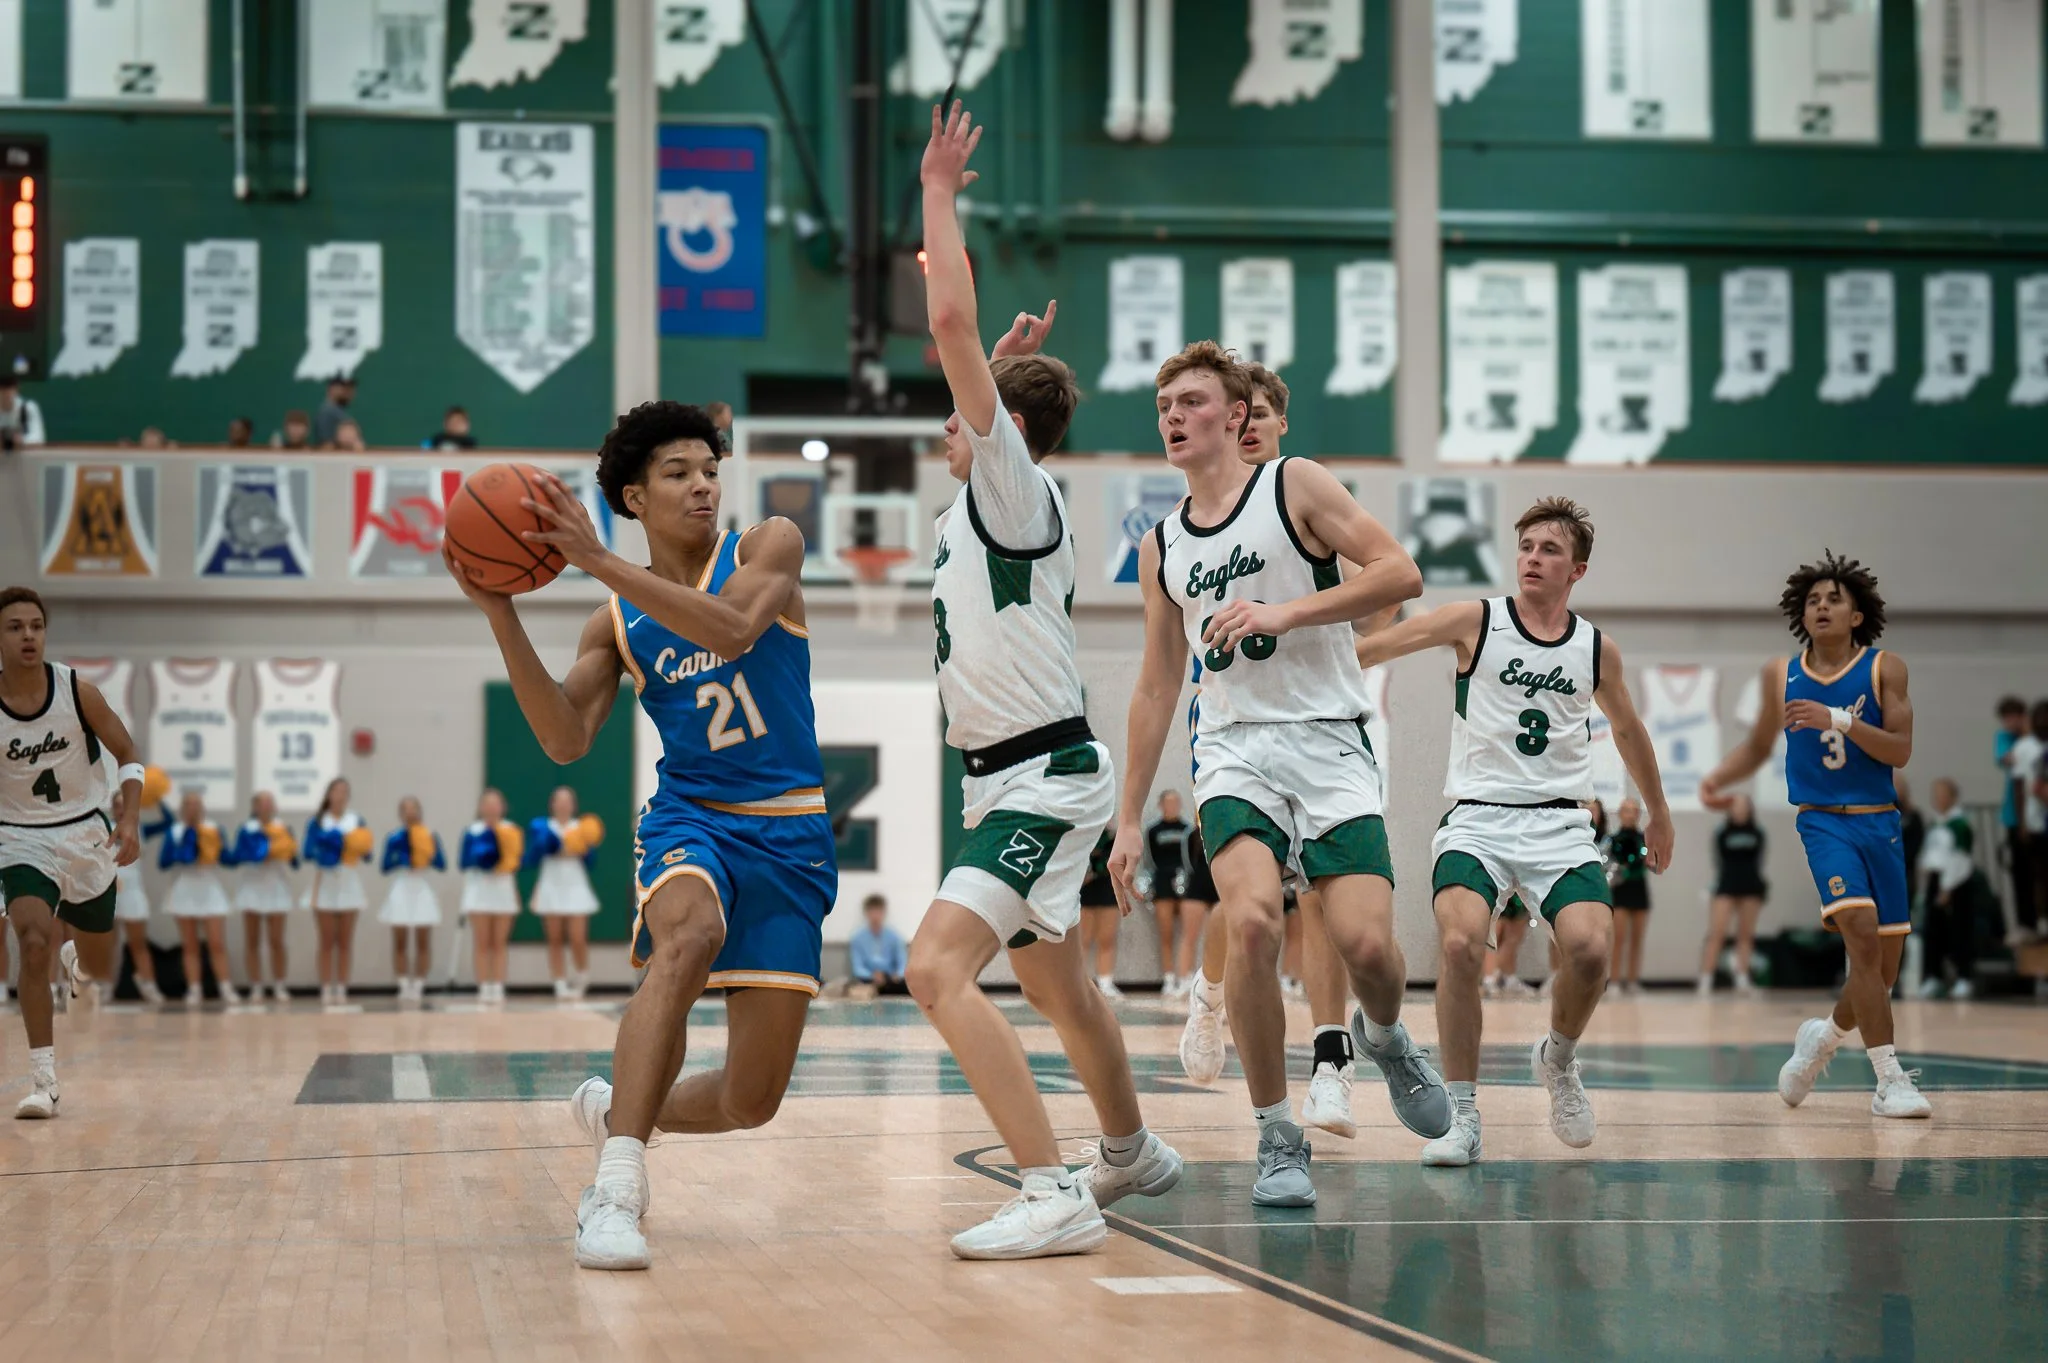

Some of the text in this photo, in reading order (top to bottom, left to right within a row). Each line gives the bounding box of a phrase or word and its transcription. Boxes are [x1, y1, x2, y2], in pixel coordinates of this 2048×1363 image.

[508, 2, 551, 40] Z
[666, 6, 706, 42] Z
[1286, 21, 1326, 59] Z
[1442, 26, 1482, 62] Z
[118, 63, 157, 94] Z
[356, 70, 391, 99] Z
[1632, 100, 1662, 133] Z
[1801, 103, 1831, 135] Z
[1968, 107, 1998, 139] Z
[1186, 544, 1265, 601] Eagles
[1499, 658, 1577, 699] Eagles
[696, 671, 768, 752] 21
[6, 731, 70, 765] Eagles
[182, 731, 204, 761] 3
[280, 731, 315, 761] 13
[1515, 709, 1550, 756] 3
[1820, 729, 1847, 770] 3
[31, 768, 61, 803] 4
[998, 828, 1045, 878] Z
